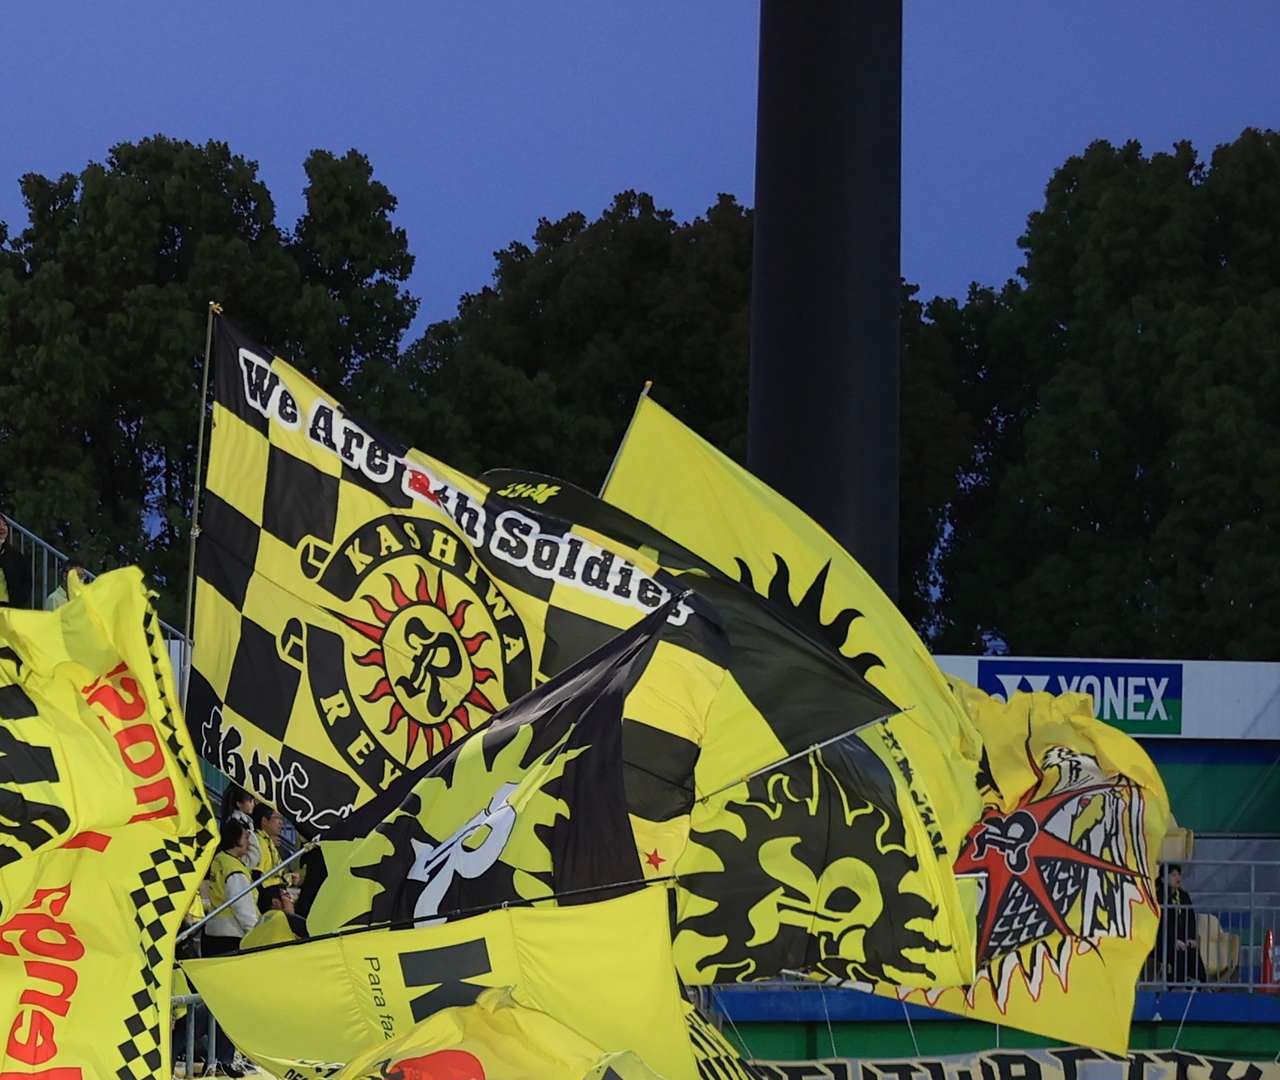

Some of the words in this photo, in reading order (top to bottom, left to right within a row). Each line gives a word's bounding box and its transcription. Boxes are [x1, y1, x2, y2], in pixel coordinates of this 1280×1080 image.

[237, 348, 301, 426] We
[306, 404, 393, 478] Are
[346, 521, 530, 666] KASHIWA
[1058, 674, 1169, 722] YONEX
[363, 955, 389, 1010] Para
